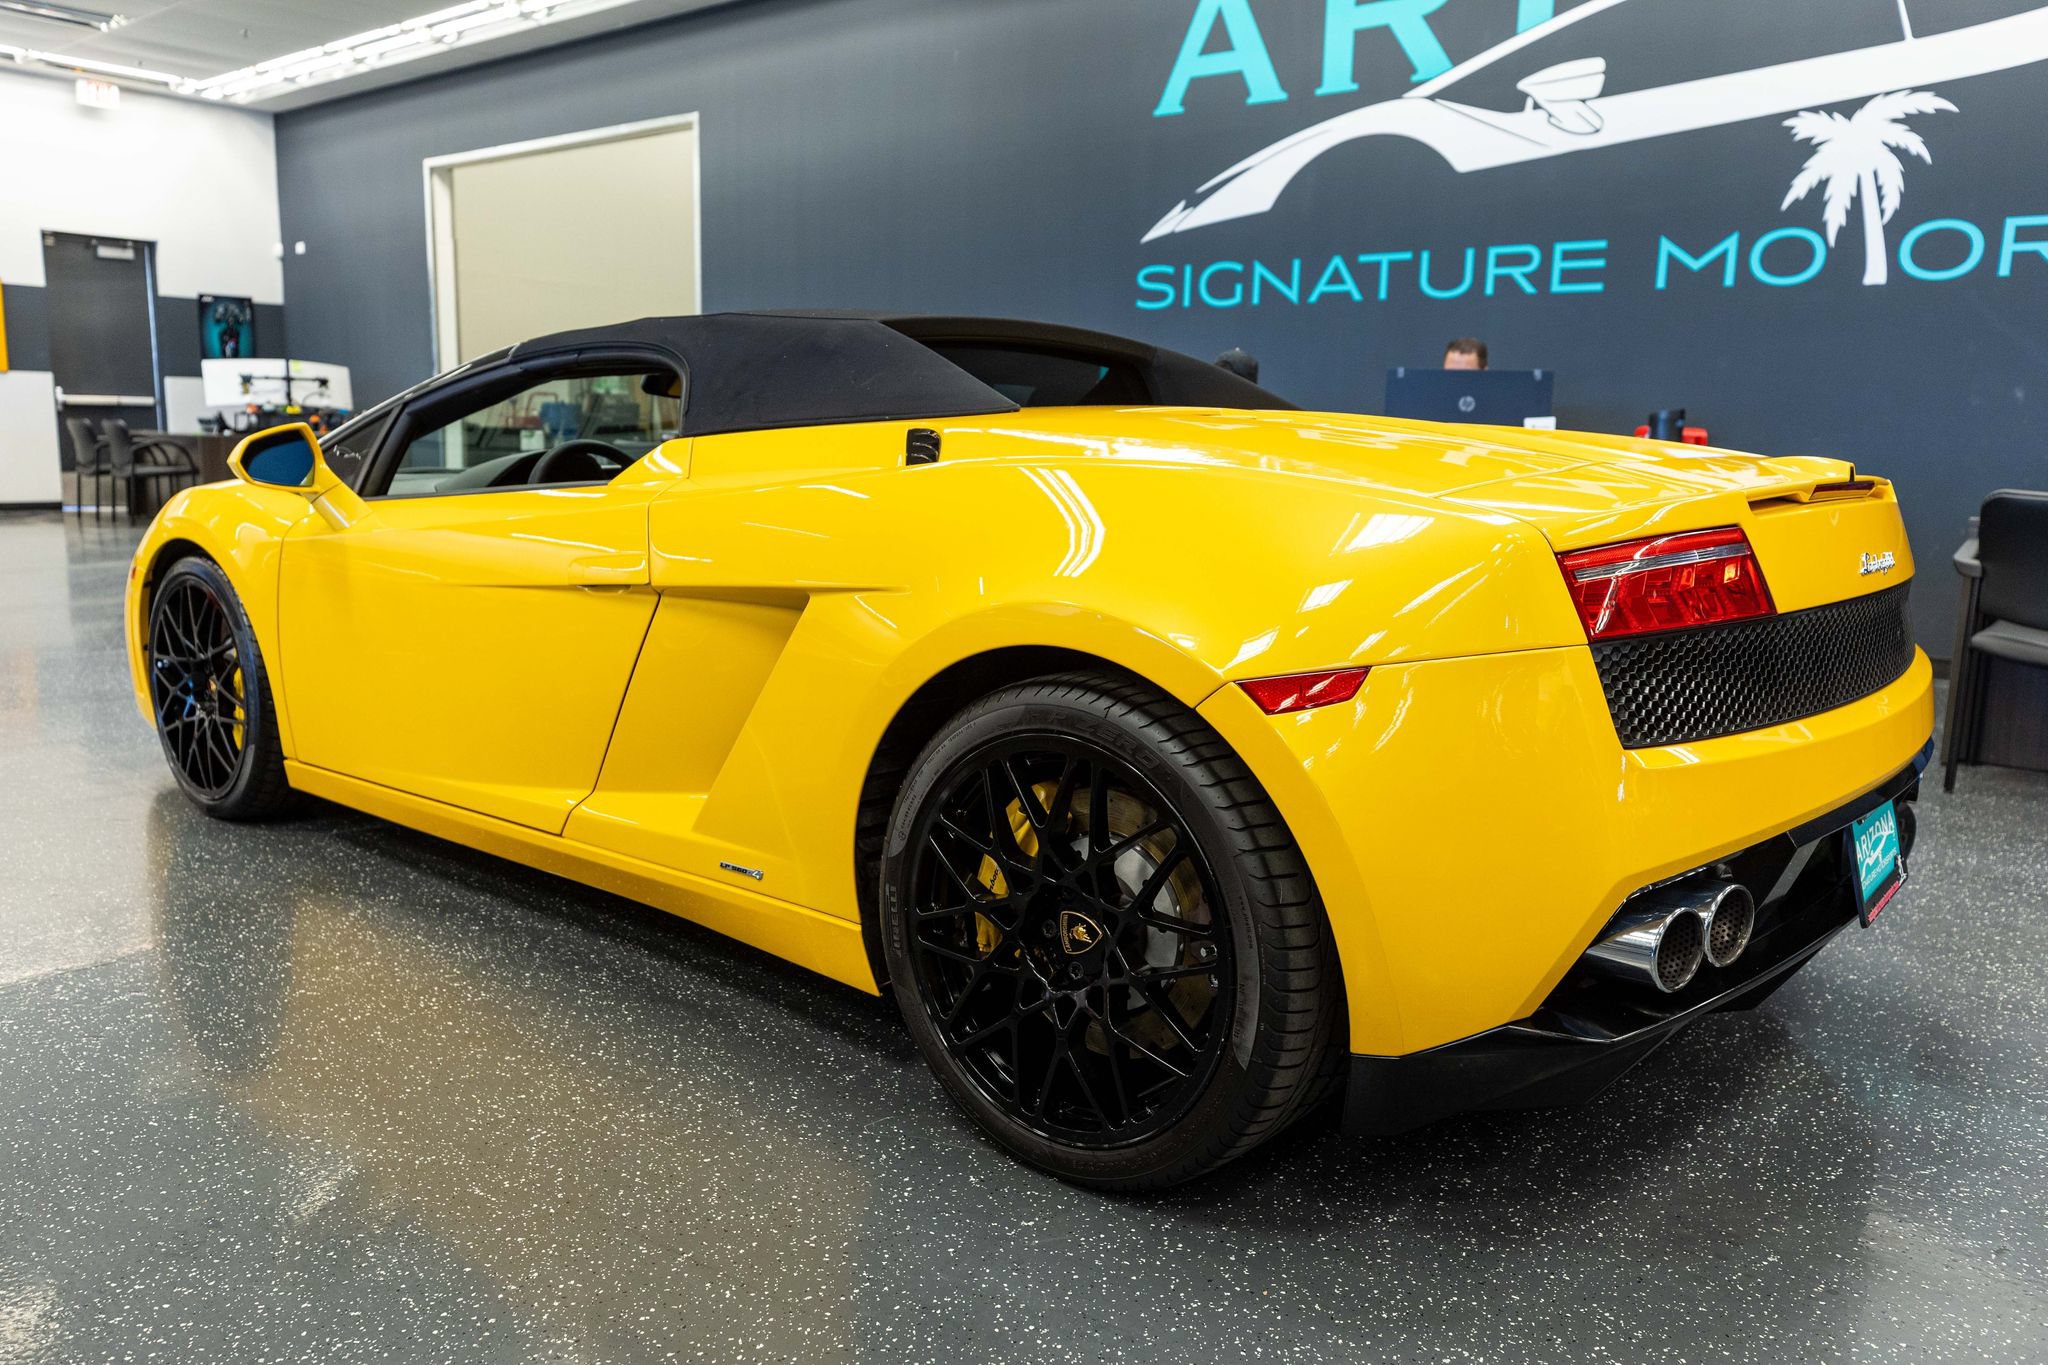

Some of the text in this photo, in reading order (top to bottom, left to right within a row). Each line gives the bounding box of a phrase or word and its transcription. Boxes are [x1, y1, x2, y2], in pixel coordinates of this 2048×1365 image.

[1153, 0, 1555, 116] AR
[1135, 239, 1608, 310] SIGNATURE
[1855, 809, 1895, 865] ARIZONA
